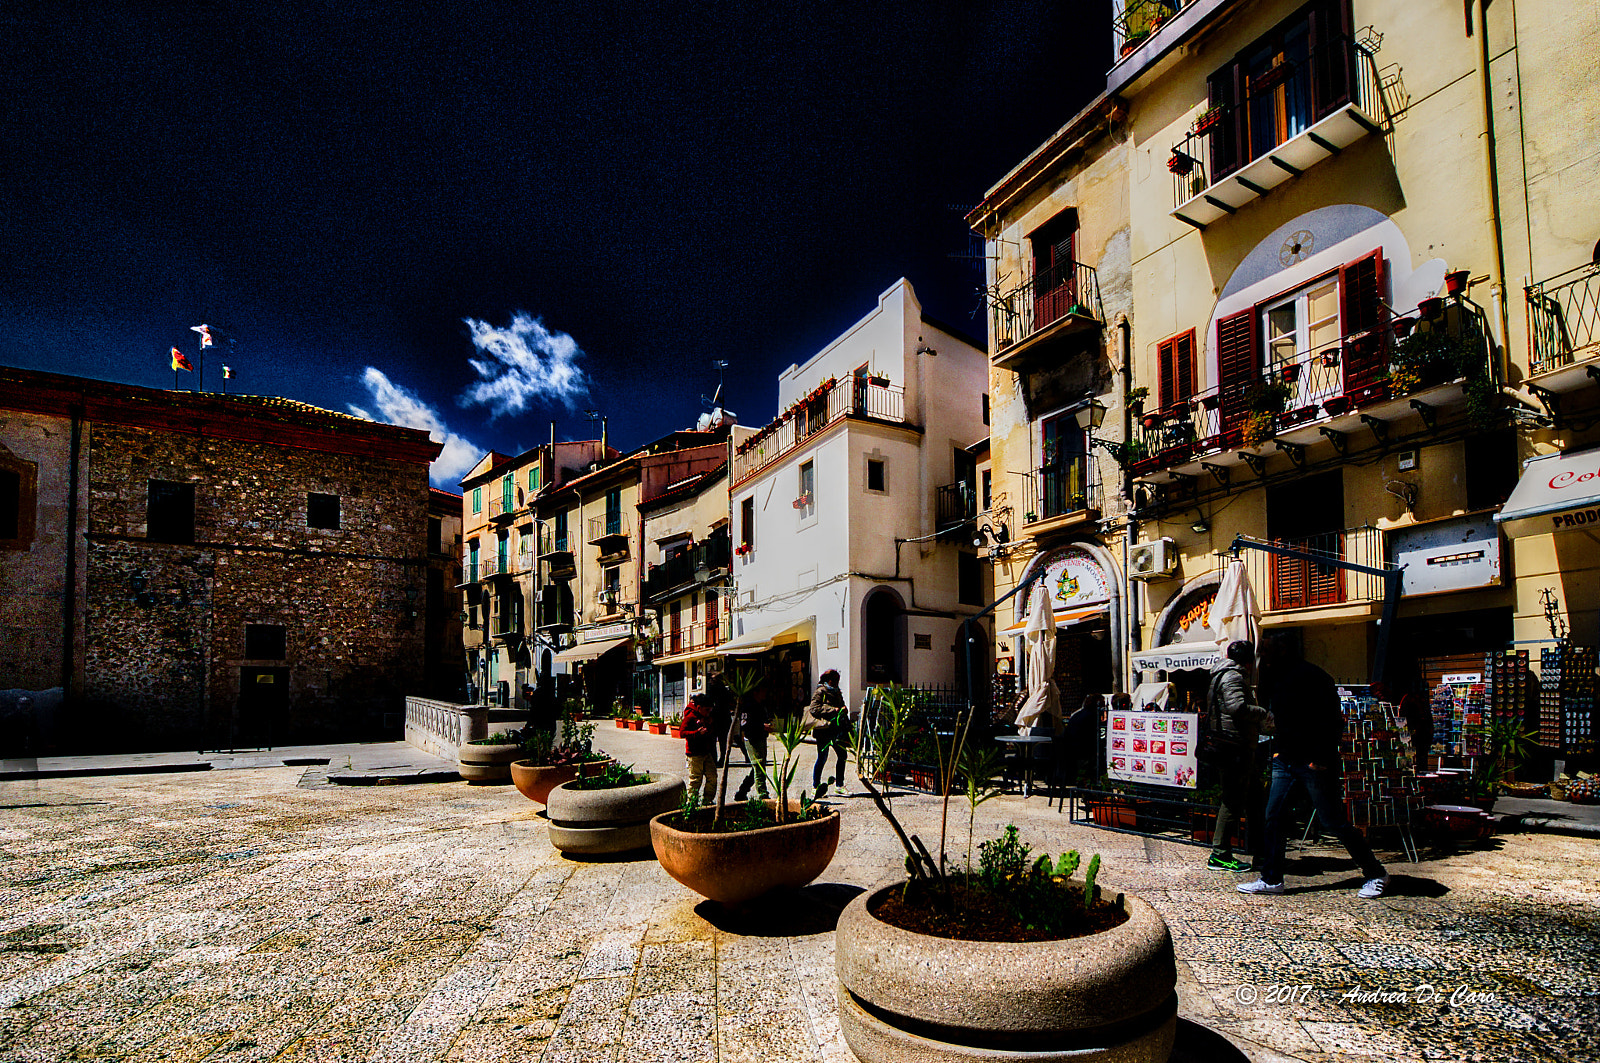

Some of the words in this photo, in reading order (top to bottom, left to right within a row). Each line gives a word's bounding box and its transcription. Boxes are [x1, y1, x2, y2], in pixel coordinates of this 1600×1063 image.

[1552, 508, 1600, 528] PROD
[1052, 559, 1082, 570] SOUVENIR
[1140, 659, 1160, 669] Bar
[1165, 655, 1220, 668] Panineria
